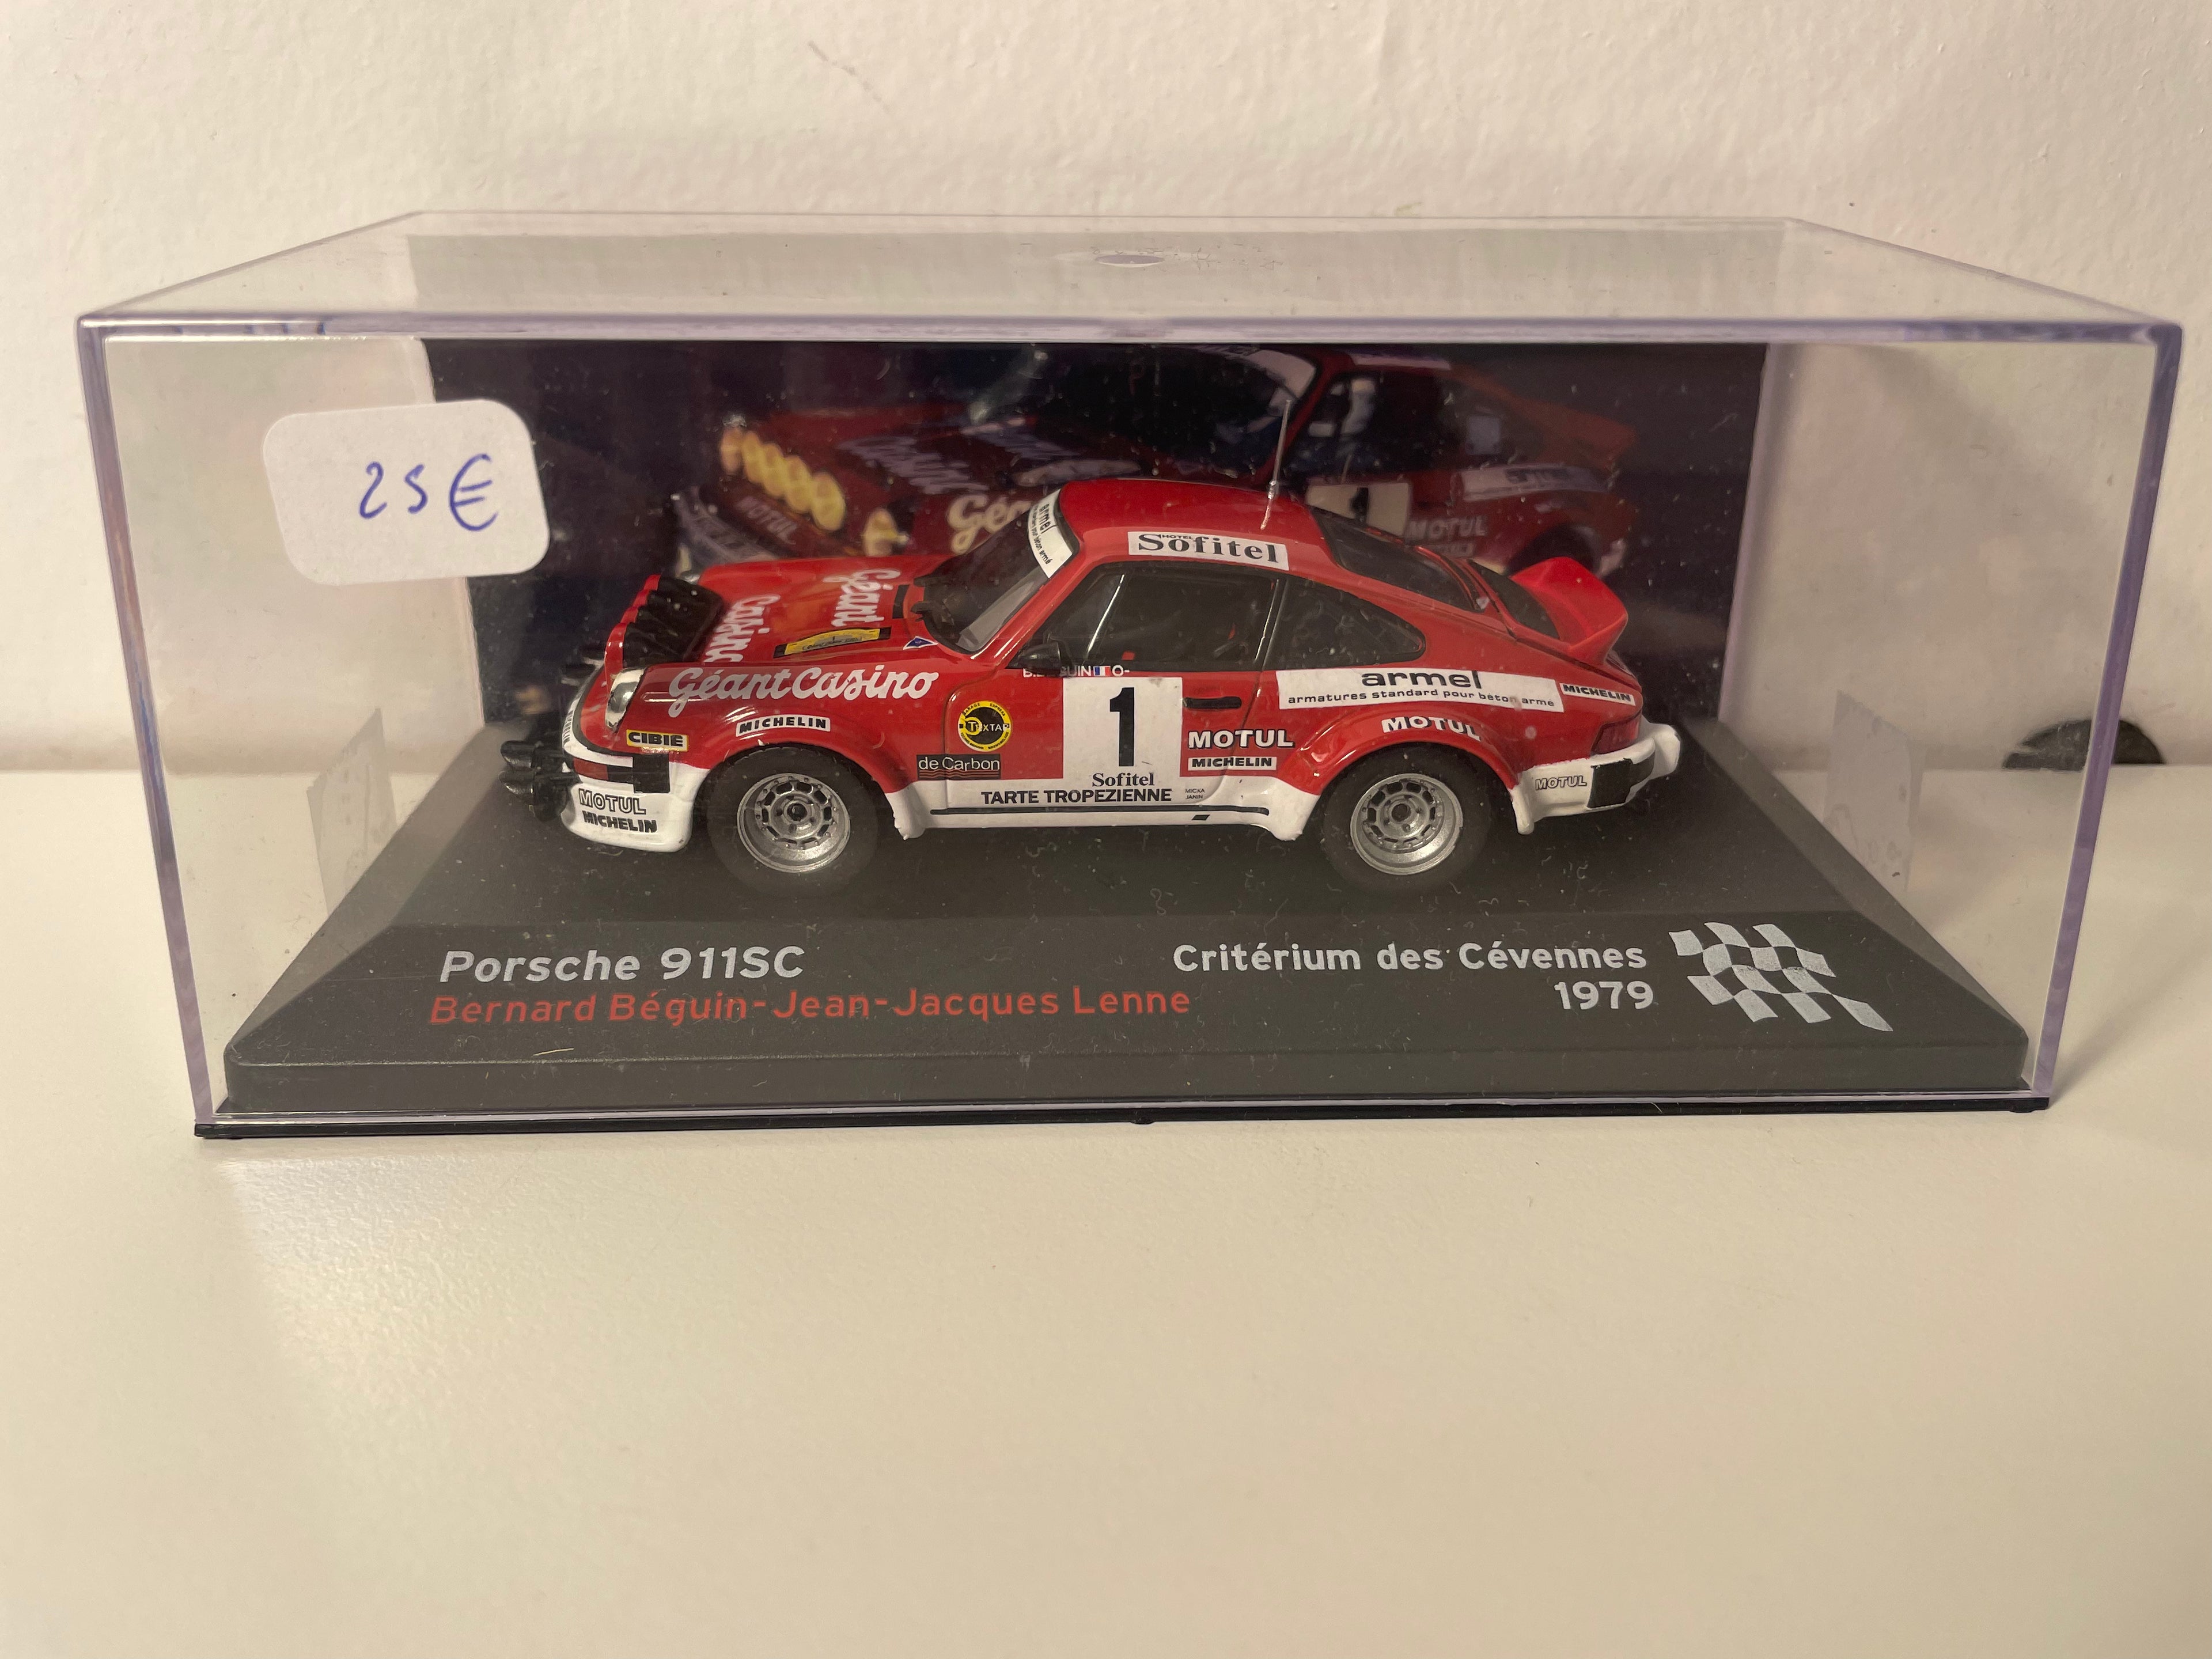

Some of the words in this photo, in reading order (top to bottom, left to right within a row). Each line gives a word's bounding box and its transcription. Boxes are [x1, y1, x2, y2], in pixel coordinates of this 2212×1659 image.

[1138, 533, 1279, 563] Sofitel
[1361, 670, 1482, 688] armel
[1288, 693, 1367, 704] armatures
[1372, 689, 1438, 699] standard
[1443, 691, 1475, 699] pour
[1563, 684, 1631, 702] MICHELIN
[740, 717, 826, 734] MICHELIN
[1110, 687, 1134, 766] 1
[1382, 716, 1481, 741] MOTUL
[1188, 729, 1295, 749] MOTUL
[918, 756, 939, 770] de
[942, 756, 1000, 771] Carbon
[1192, 757, 1272, 767] MICHELIN
[1092, 772, 1155, 787] Sofitel
[1535, 775, 1587, 791] MOTUL
[578, 788, 646, 815] MOTUL
[981, 790, 1038, 805] TARTE
[1042, 788, 1172, 804] TROPEZIENNE
[582, 810, 657, 833] MICHELIN
[440, 949, 641, 983] Porsche
[660, 946, 804, 980] 911SC
[1173, 942, 1361, 972] Critérium
[1376, 942, 1444, 970] des
[1458, 941, 1647, 969] Cévennes
[429, 994, 597, 1024] Bernard
[1073, 985, 1191, 1014] Lenne
[1554, 980, 1654, 1010] 1979
